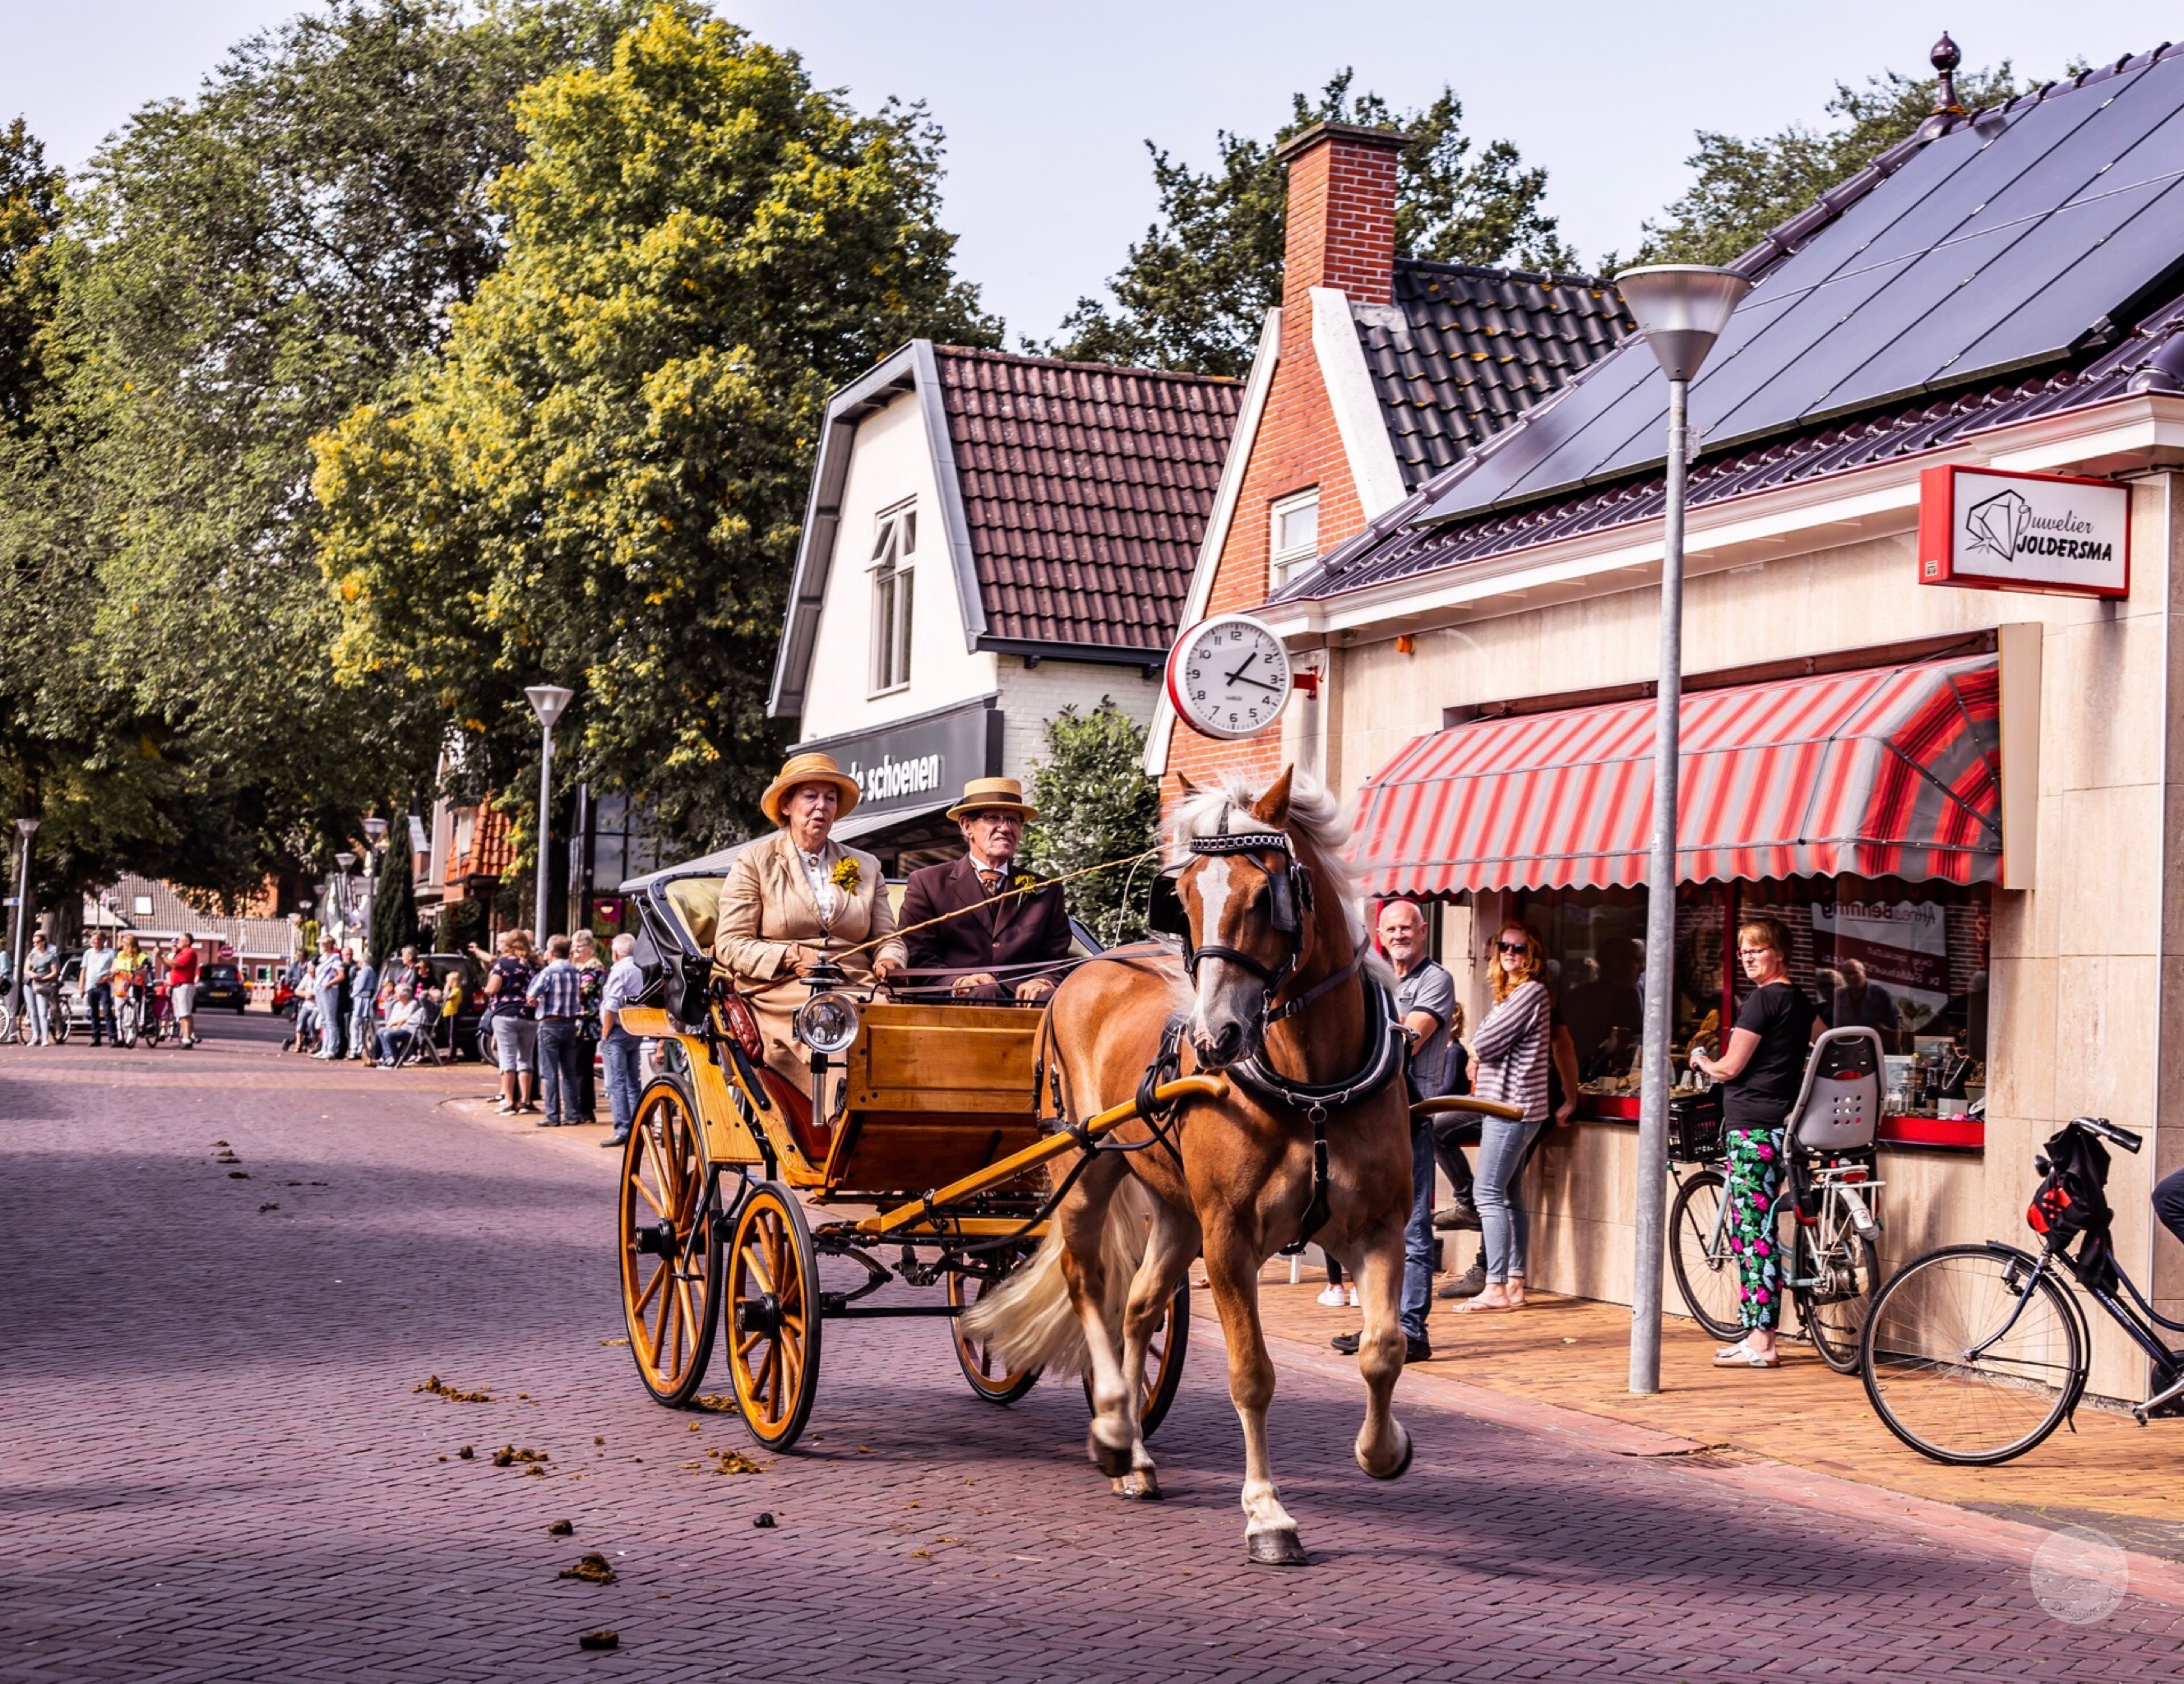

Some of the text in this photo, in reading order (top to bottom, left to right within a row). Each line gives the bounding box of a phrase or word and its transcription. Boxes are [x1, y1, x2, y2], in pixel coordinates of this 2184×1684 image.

[2018, 504, 2094, 534] Juwelier
[2017, 535, 2112, 561] JOLDERSMA
[1215, 636, 1222, 645] 11
[1230, 631, 1242, 641] 12
[1255, 639, 1259, 648] 1
[1200, 649, 1211, 659] 10
[1264, 654, 1273, 664] 2
[1191, 669, 1201, 679] 9
[1270, 674, 1278, 684] 3
[1197, 690, 1206, 700] 8
[1261, 695, 1270, 705] 4
[1212, 706, 1220, 715] 7
[1249, 708, 1257, 718] 5
[1229, 713, 1238, 723] 6
[868, 754, 939, 801] schoenen
